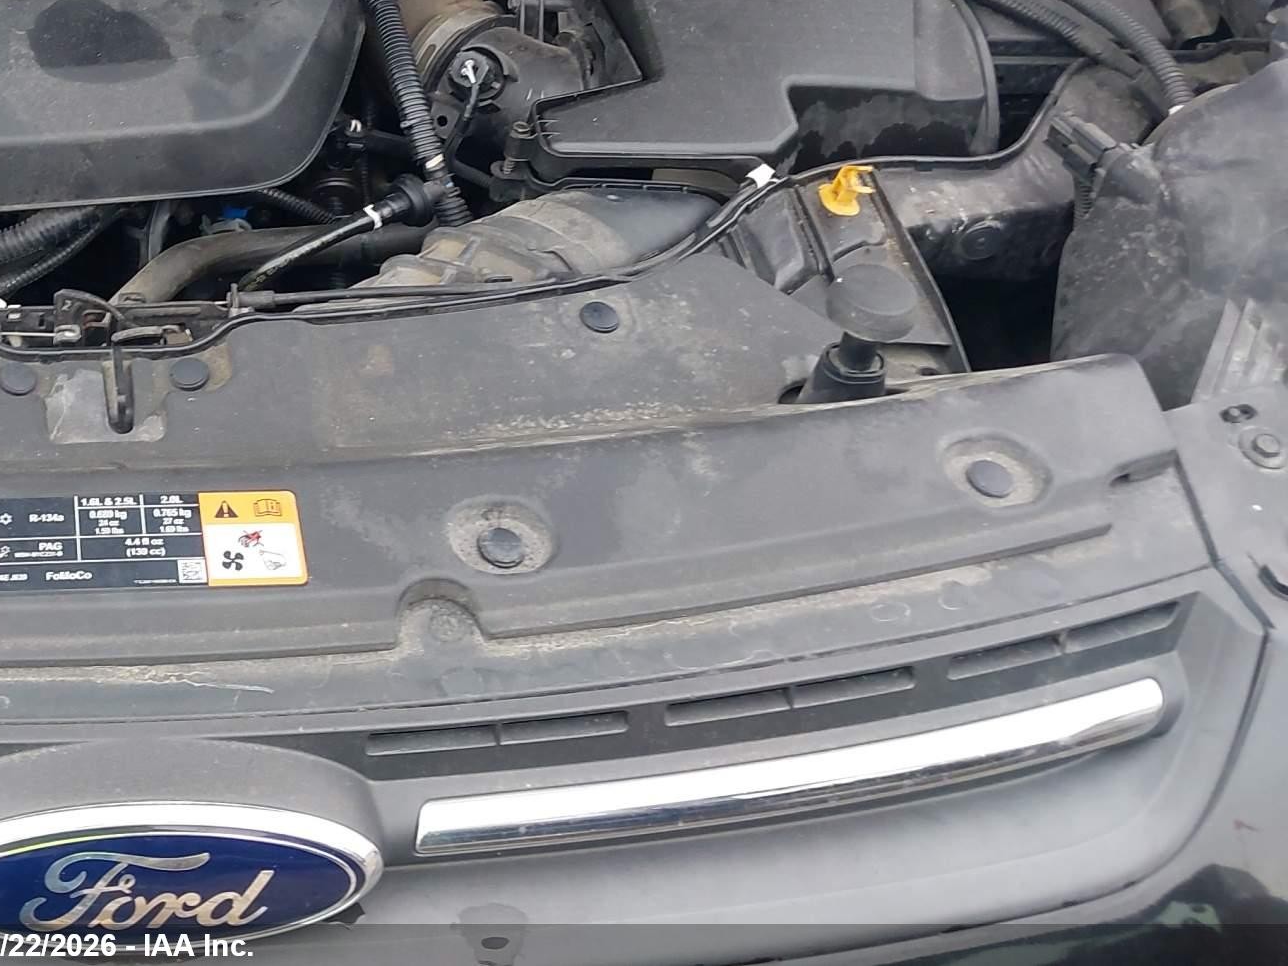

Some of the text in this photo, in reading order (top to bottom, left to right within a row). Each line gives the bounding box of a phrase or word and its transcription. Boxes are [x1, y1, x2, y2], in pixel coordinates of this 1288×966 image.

[29, 514, 65, 523] R-134a
[38, 542, 63, 551] PAG
[45, 571, 93, 581] FoMoCo
[19, 850, 275, 933] Ford
